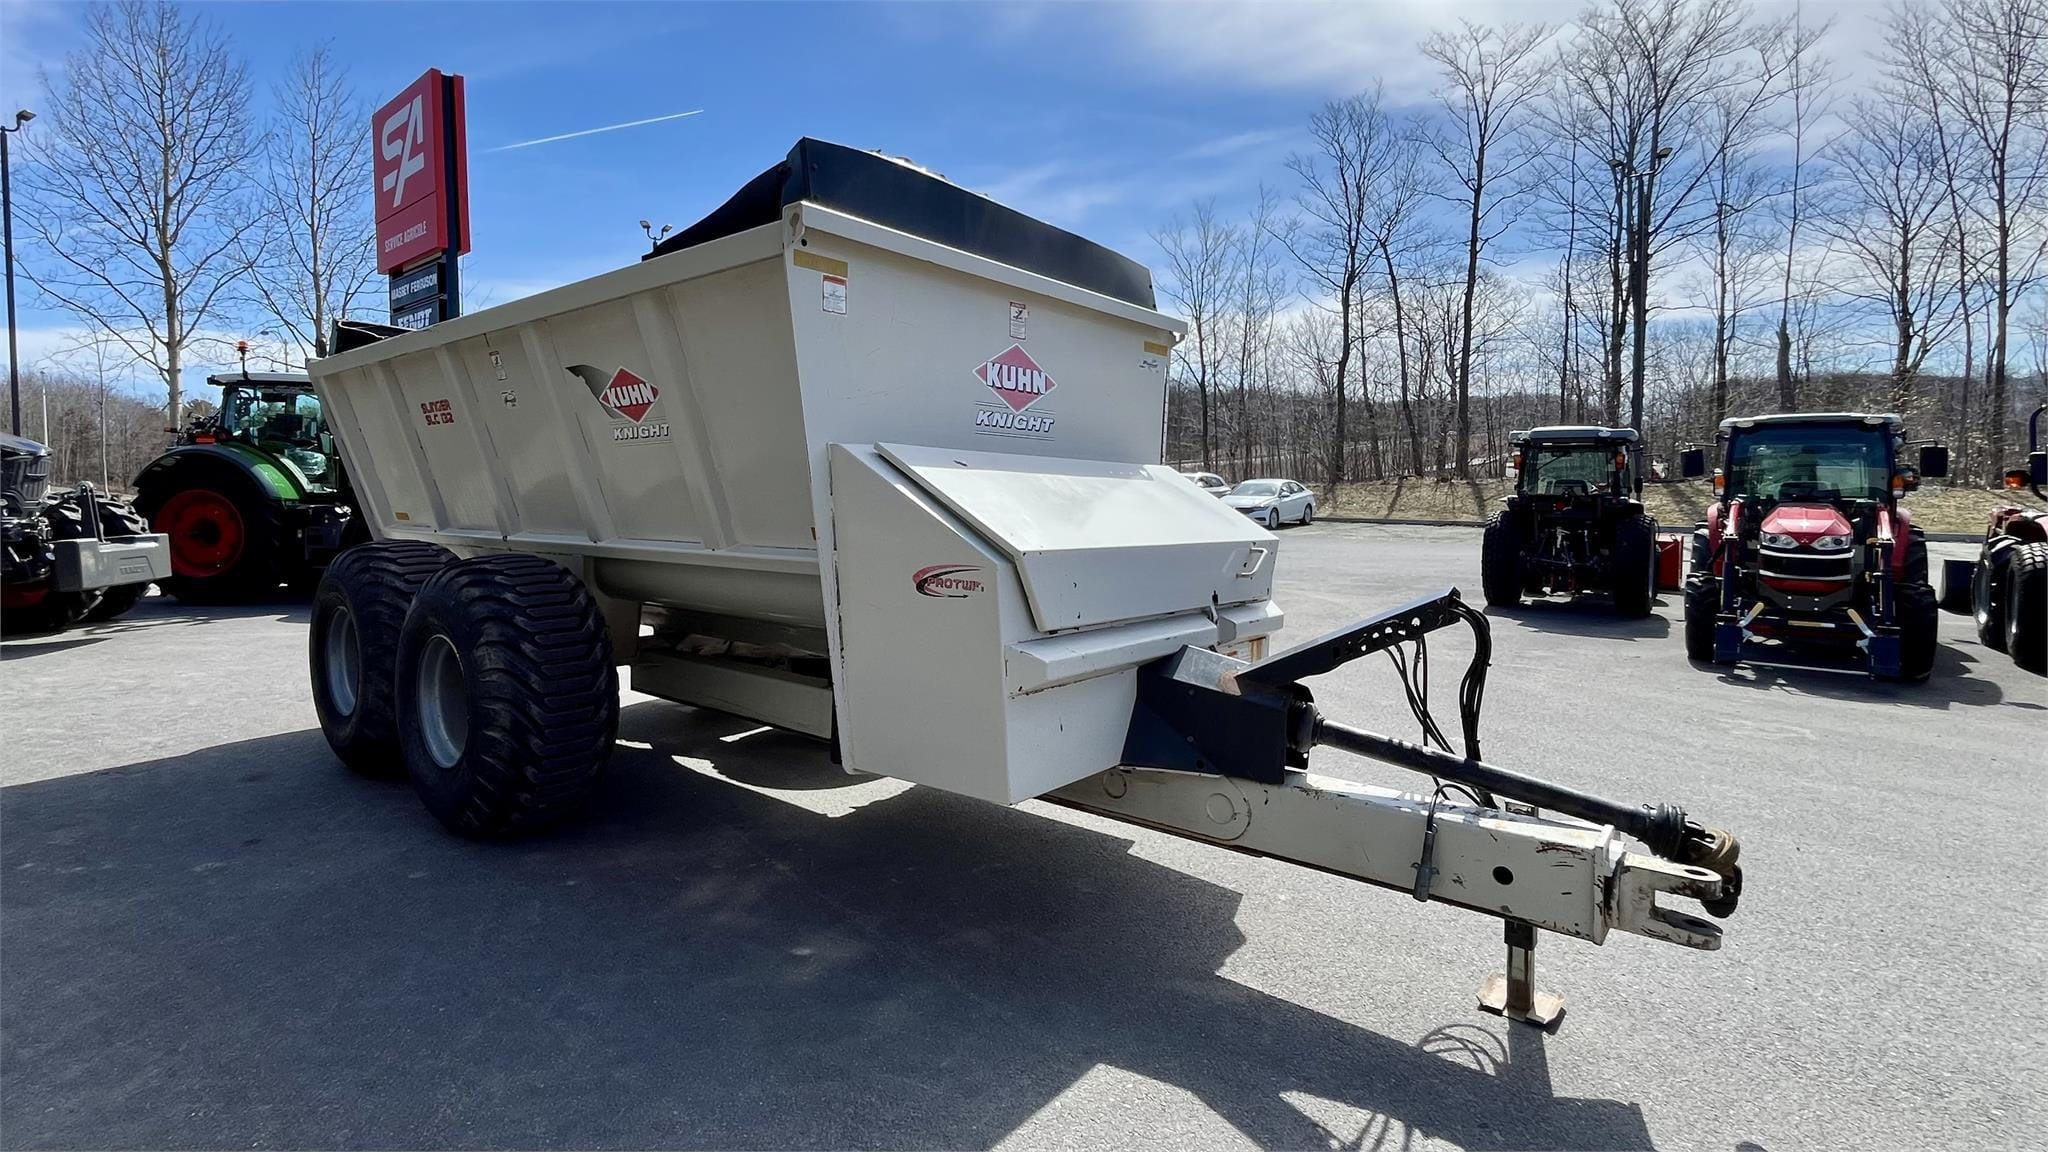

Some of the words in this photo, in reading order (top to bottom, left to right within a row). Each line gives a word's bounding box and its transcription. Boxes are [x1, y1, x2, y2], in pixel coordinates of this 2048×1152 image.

[384, 232, 404, 253] SERVICE
[404, 220, 427, 243] AGRICOLE
[391, 283, 410, 300] MASSEY
[410, 273, 437, 293] FERGUSON
[397, 307, 433, 329] FENDT
[986, 361, 1047, 395] KUHN
[420, 399, 452, 415] SLINGER
[606, 382, 656, 409] KUHN
[425, 413, 441, 426] SLC
[440, 412, 455, 424] 132
[976, 410, 1054, 433] KNIGHT
[614, 424, 669, 441] KNIGHT
